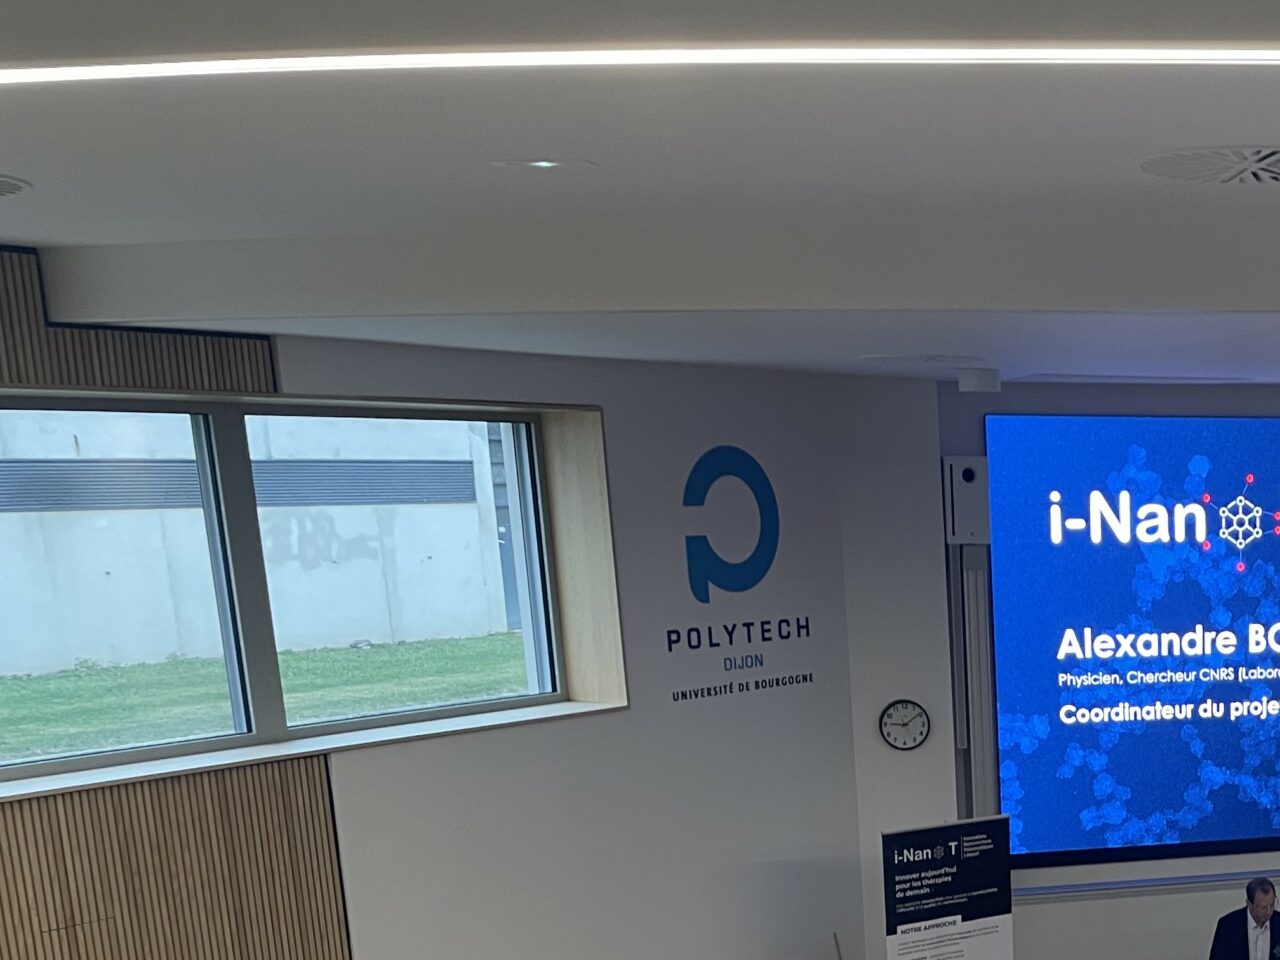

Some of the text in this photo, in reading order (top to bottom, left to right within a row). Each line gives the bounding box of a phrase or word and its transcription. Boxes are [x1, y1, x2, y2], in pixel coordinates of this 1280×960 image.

[666, 616, 811, 652] POLYTECH
[1056, 624, 1237, 660] Alexandre
[723, 653, 764, 671] DIJON
[672, 672, 814, 702] UNIVERSITÉ DE BOURGOGNE
[1058, 672, 1123, 688] Physicien,
[1126, 669, 1197, 684] Chercheur
[1199, 667, 1234, 682] CNRS
[1059, 701, 1194, 724] Coordinateur
[1198, 698, 1224, 718] du
[895, 882, 911, 892] pour
[905, 887, 930, 897] demain
[901, 920, 957, 936] NOTRE APPROCHE
